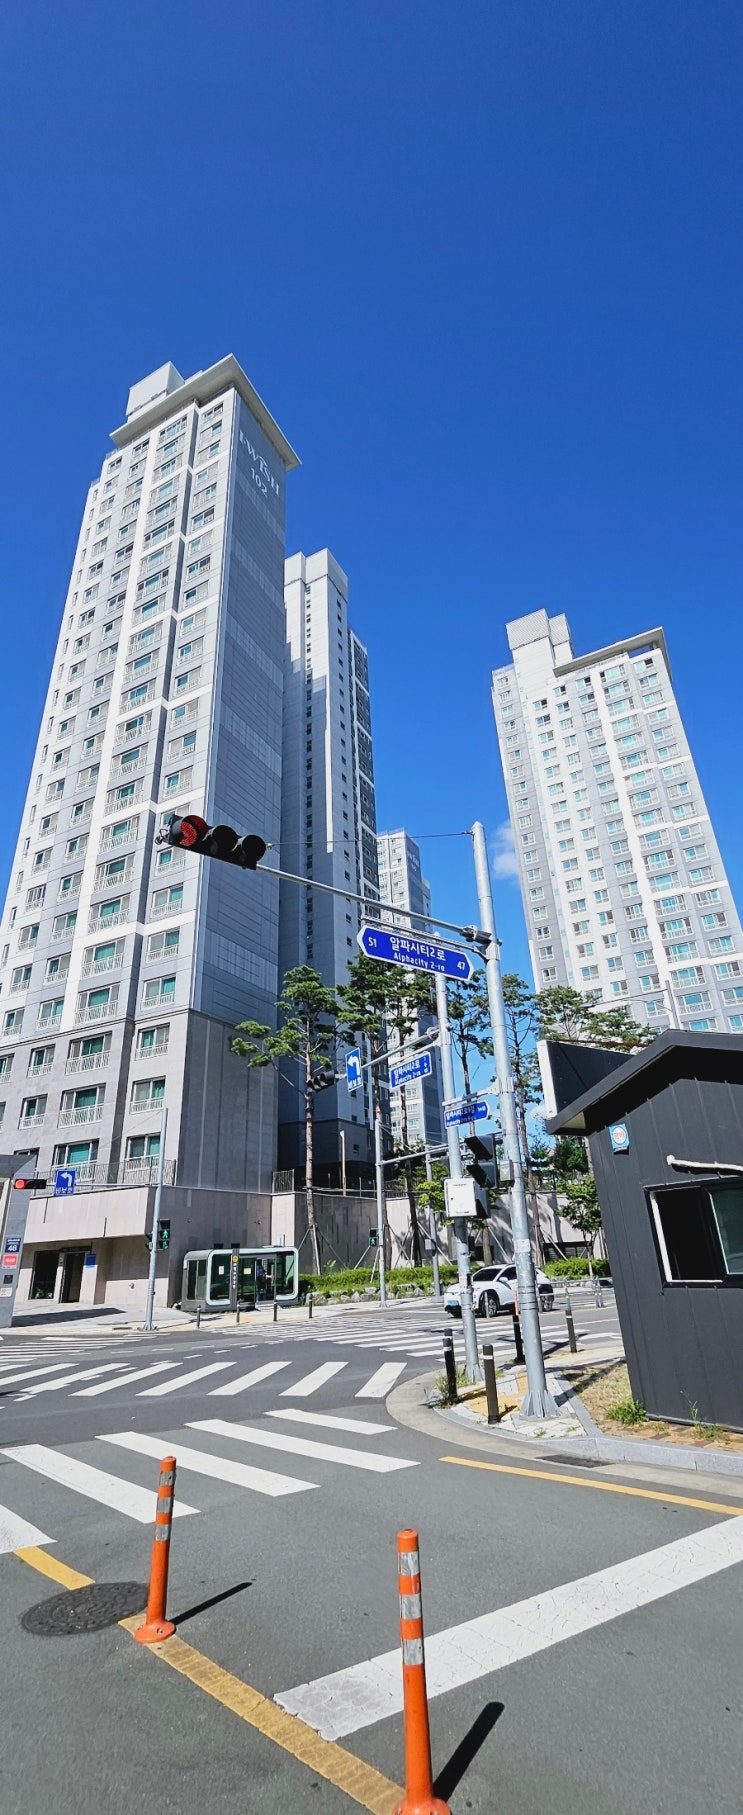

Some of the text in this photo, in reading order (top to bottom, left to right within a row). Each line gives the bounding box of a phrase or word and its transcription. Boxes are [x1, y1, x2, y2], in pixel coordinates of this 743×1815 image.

[251, 467, 268, 497] 102
[368, 937, 377, 948] 51
[389, 936, 446, 961] 알파시티2로
[393, 952, 445, 972] Alphacity 2-ro
[457, 961, 466, 971] 47
[393, 1060, 421, 1079] 알파시티2로
